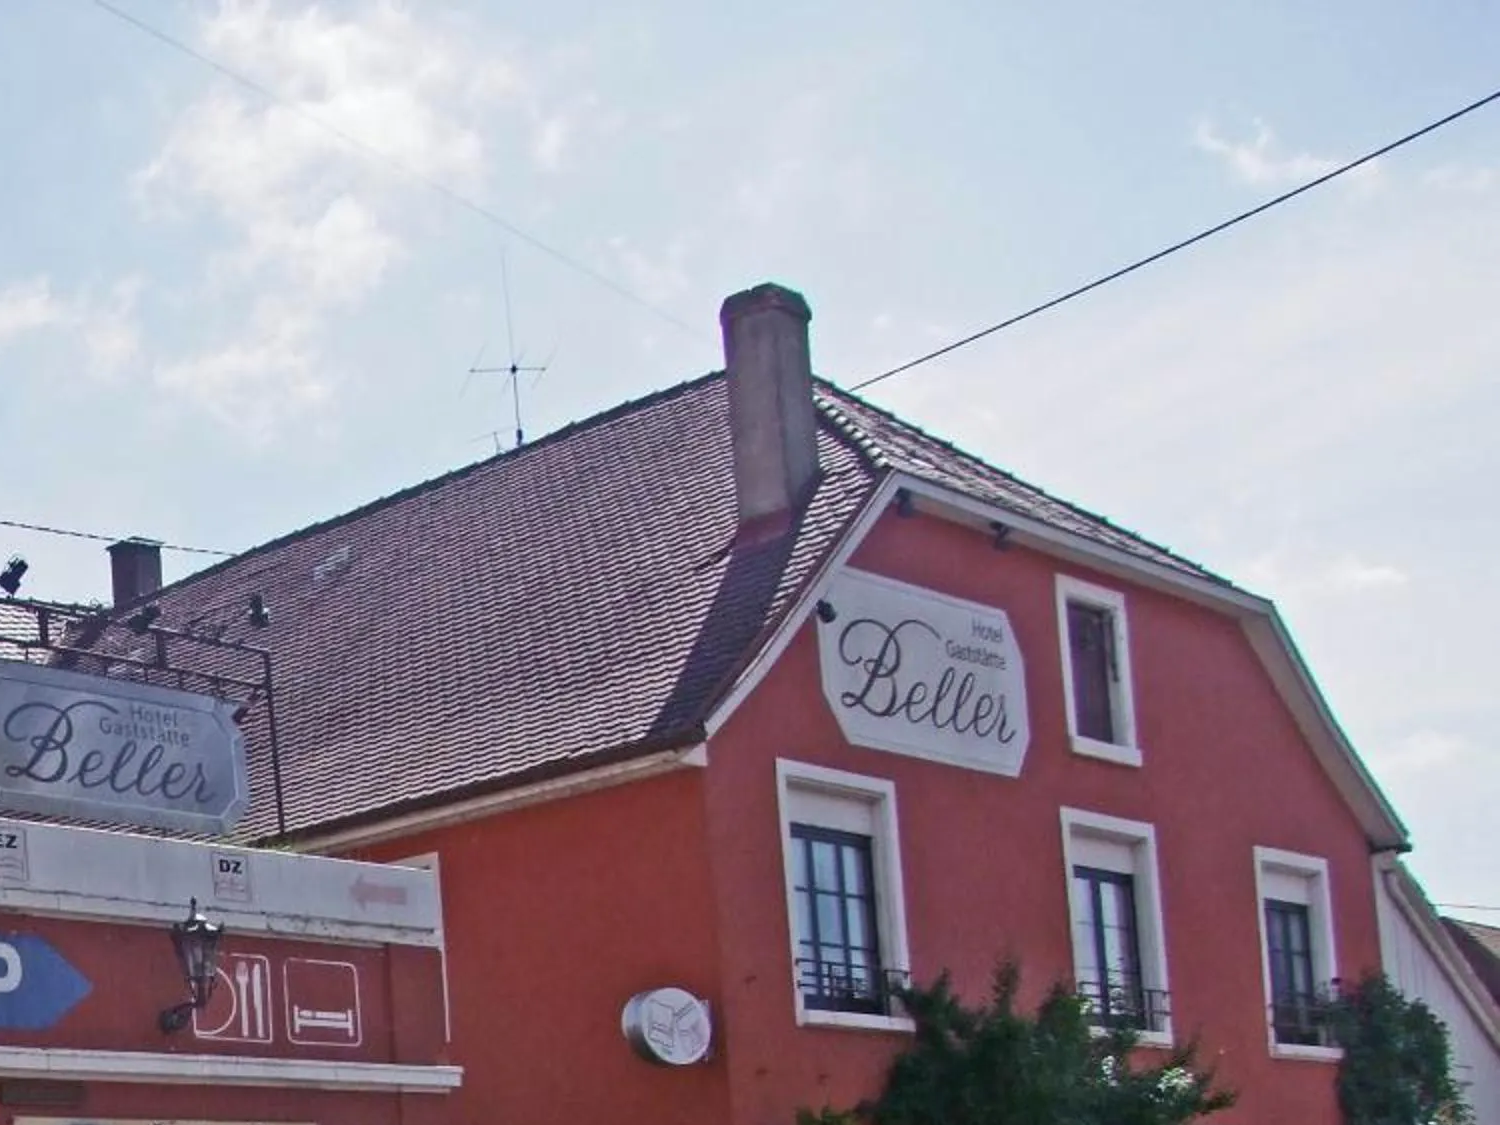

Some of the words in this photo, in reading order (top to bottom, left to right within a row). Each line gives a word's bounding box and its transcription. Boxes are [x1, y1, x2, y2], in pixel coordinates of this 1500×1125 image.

[970, 616, 1004, 643] Hotel
[838, 618, 1017, 744] Beller
[129, 702, 179, 728] Hotel
[3, 699, 216, 803] Beller
[219, 858, 243, 875] DZ
